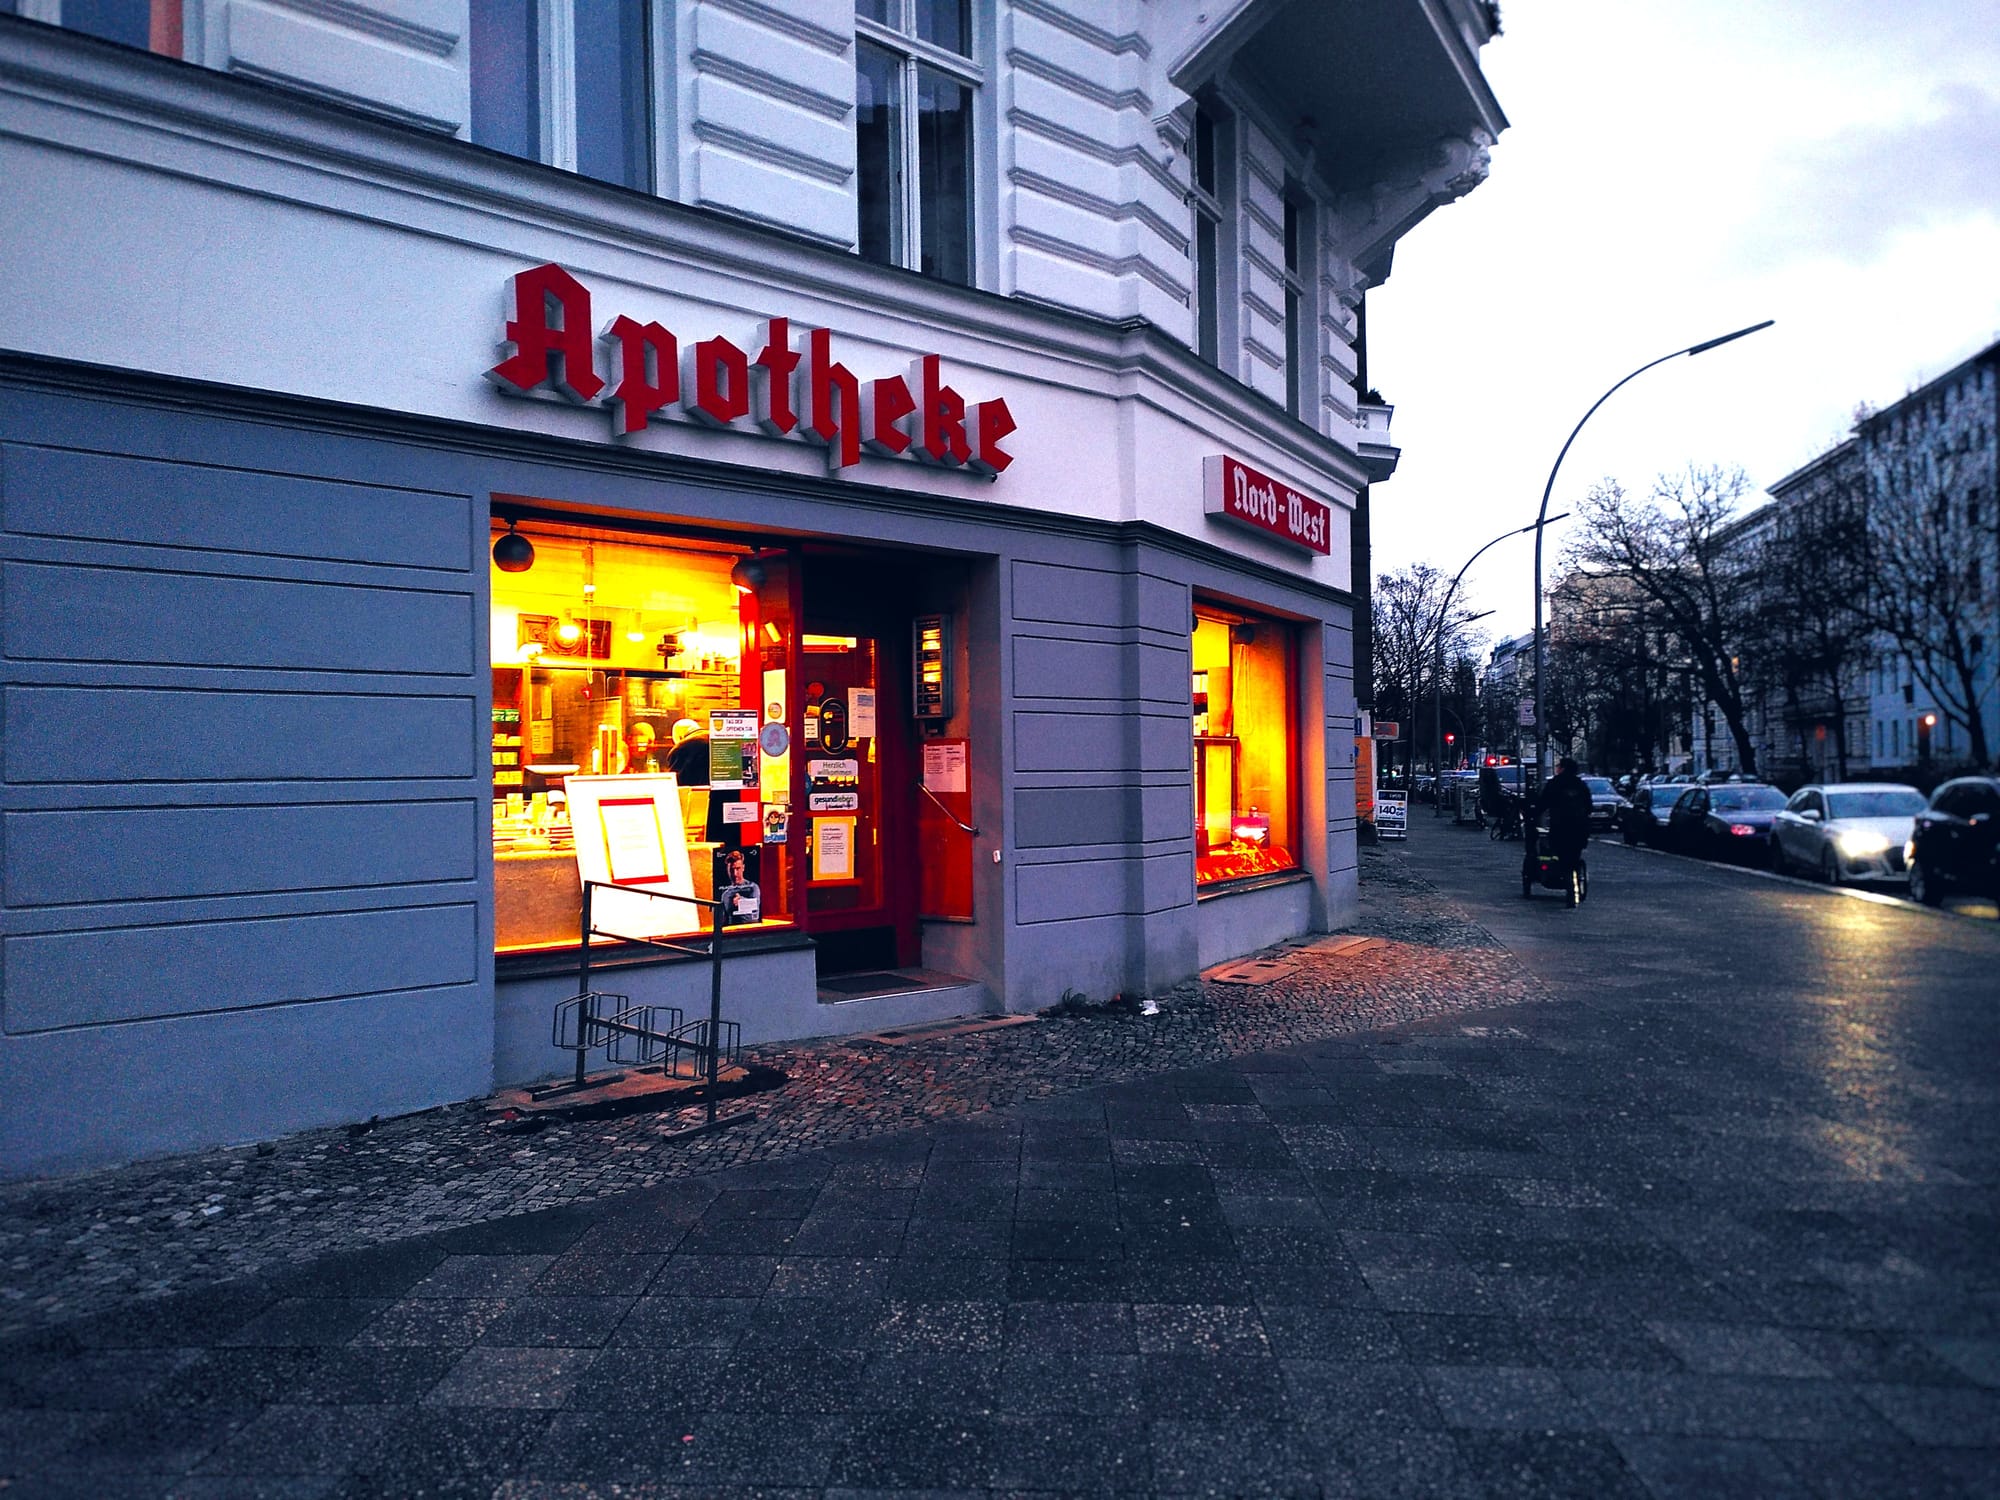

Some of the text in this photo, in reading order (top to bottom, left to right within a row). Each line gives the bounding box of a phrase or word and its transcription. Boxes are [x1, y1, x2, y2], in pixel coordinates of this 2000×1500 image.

[489, 262, 1018, 473] Apotheke
[1233, 464, 1326, 547] Nord-West
[823, 761, 847, 769] Herzlich
[1379, 805, 1396, 815] 140
